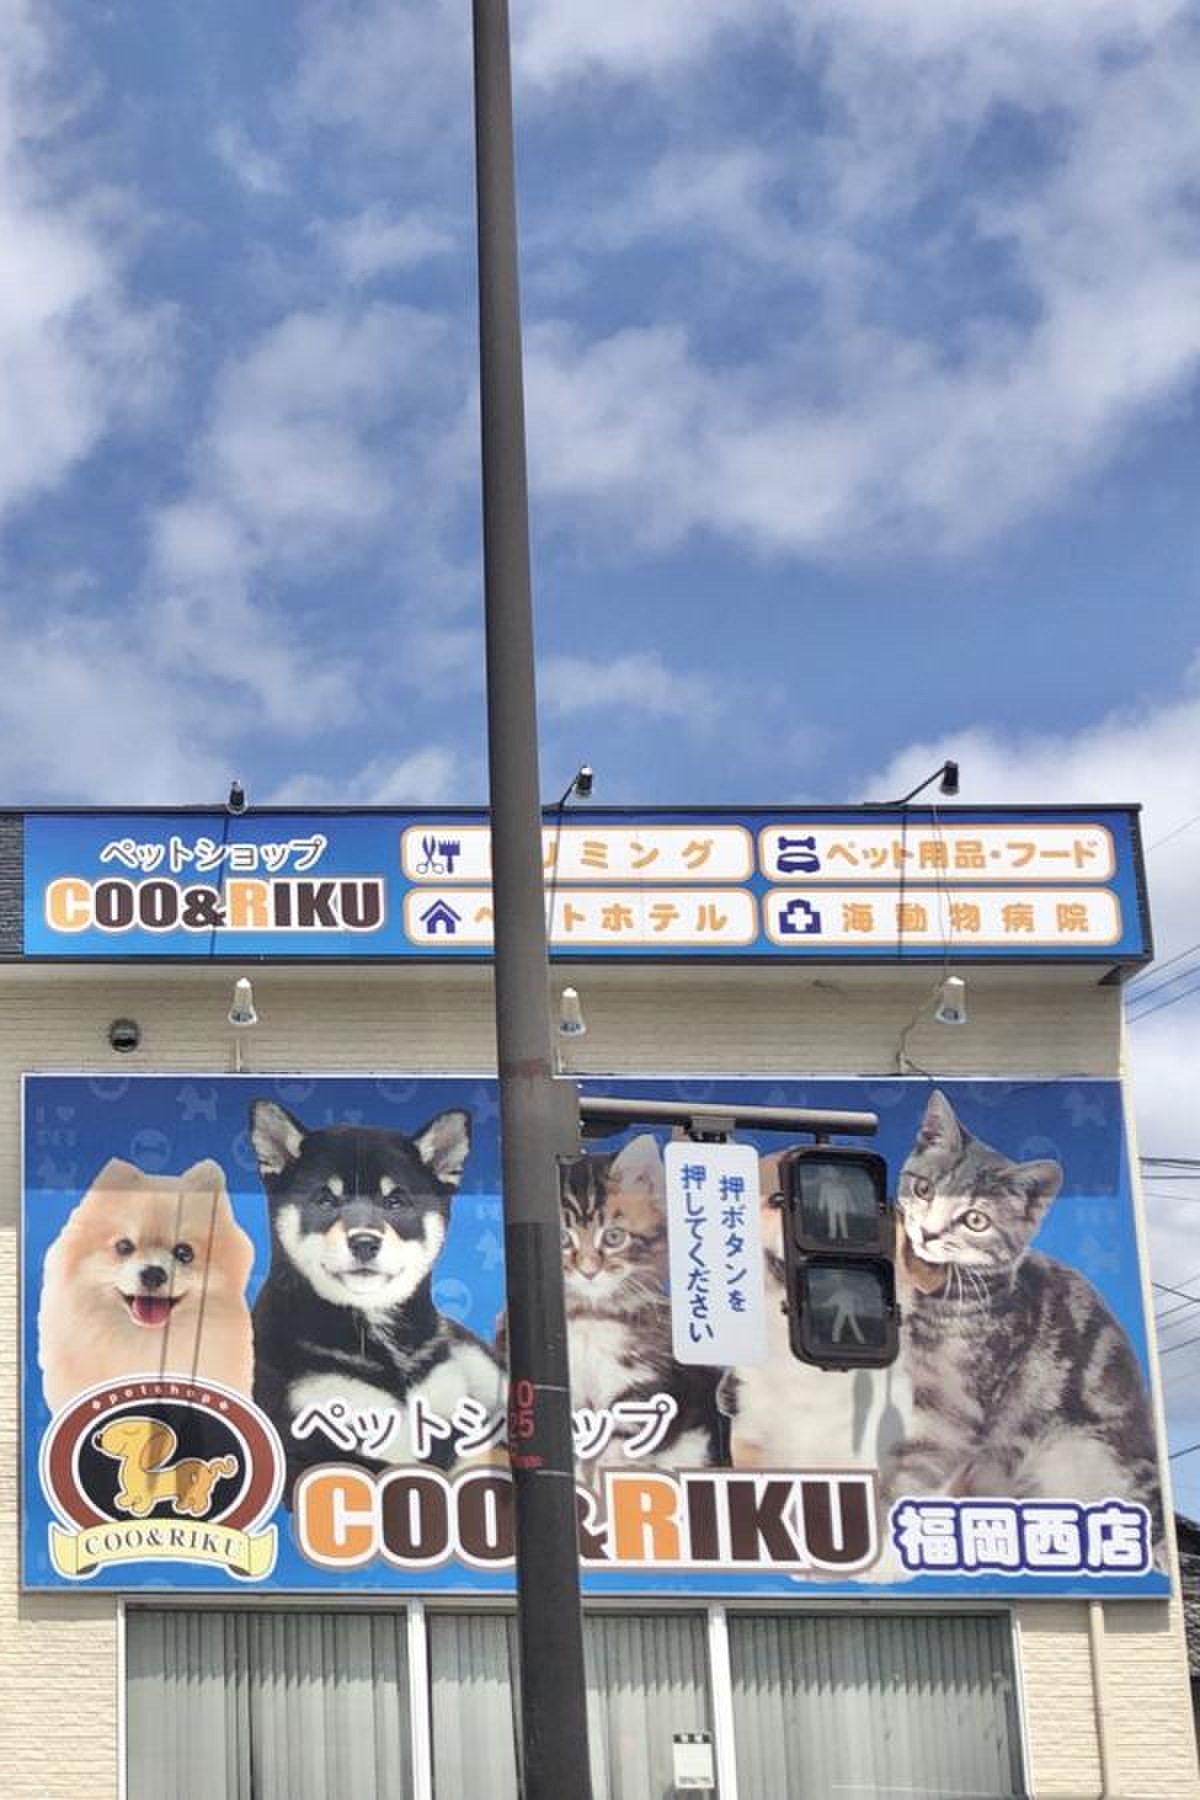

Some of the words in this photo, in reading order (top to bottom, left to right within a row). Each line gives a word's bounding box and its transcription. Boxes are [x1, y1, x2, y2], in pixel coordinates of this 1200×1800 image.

[101, 834, 327, 872] ペットショップ
[826, 839, 1098, 870] ペット用品・フード
[47, 878, 384, 931] COO&RIKU
[842, 902, 1090, 934] 海動物病院
[680, 1164, 714, 1343] 押してください
[719, 1175, 748, 1313] 押ボタンを
[292, 1394, 676, 1458] ペットシップ
[85, 1528, 241, 1557] COO&RIKU
[892, 1500, 1149, 1572] 福岡西店
